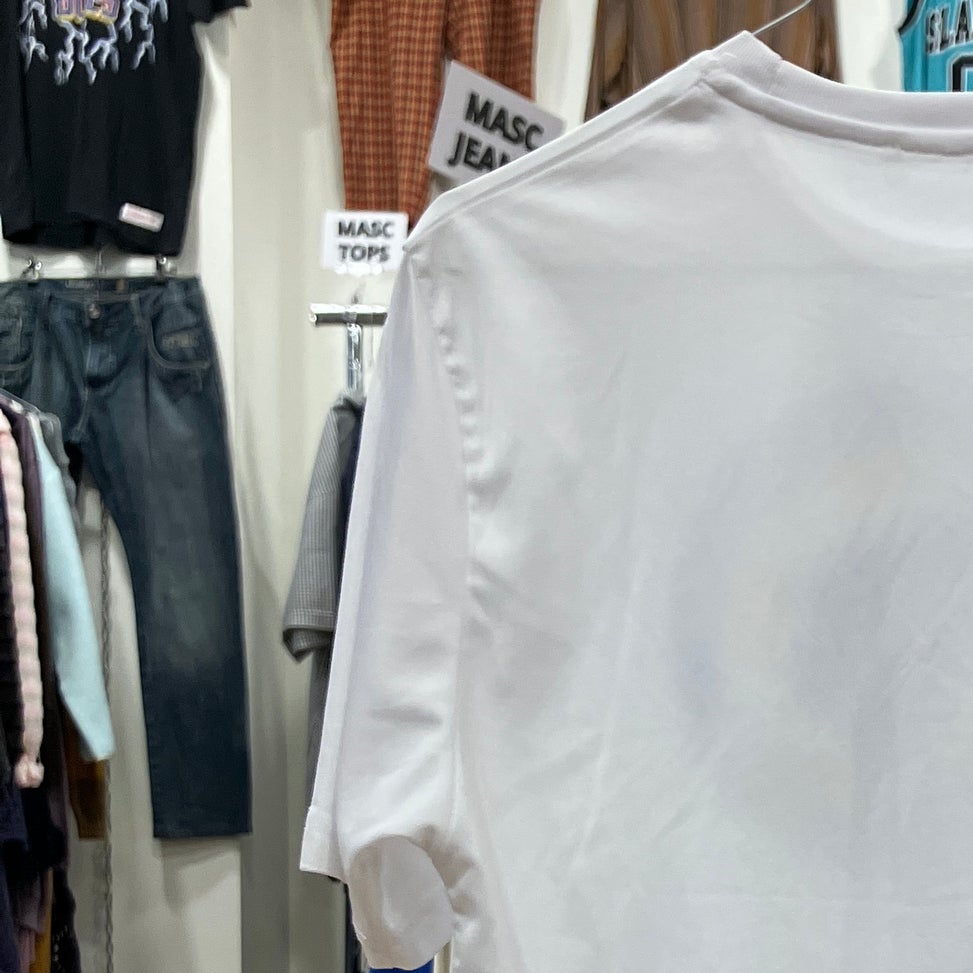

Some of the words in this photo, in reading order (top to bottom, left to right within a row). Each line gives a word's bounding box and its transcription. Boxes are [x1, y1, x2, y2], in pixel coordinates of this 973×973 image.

[465, 91, 545, 151] MASC
[447, 131, 512, 171] JEA
[338, 220, 394, 238] MASC
[338, 244, 390, 262] TOPS
